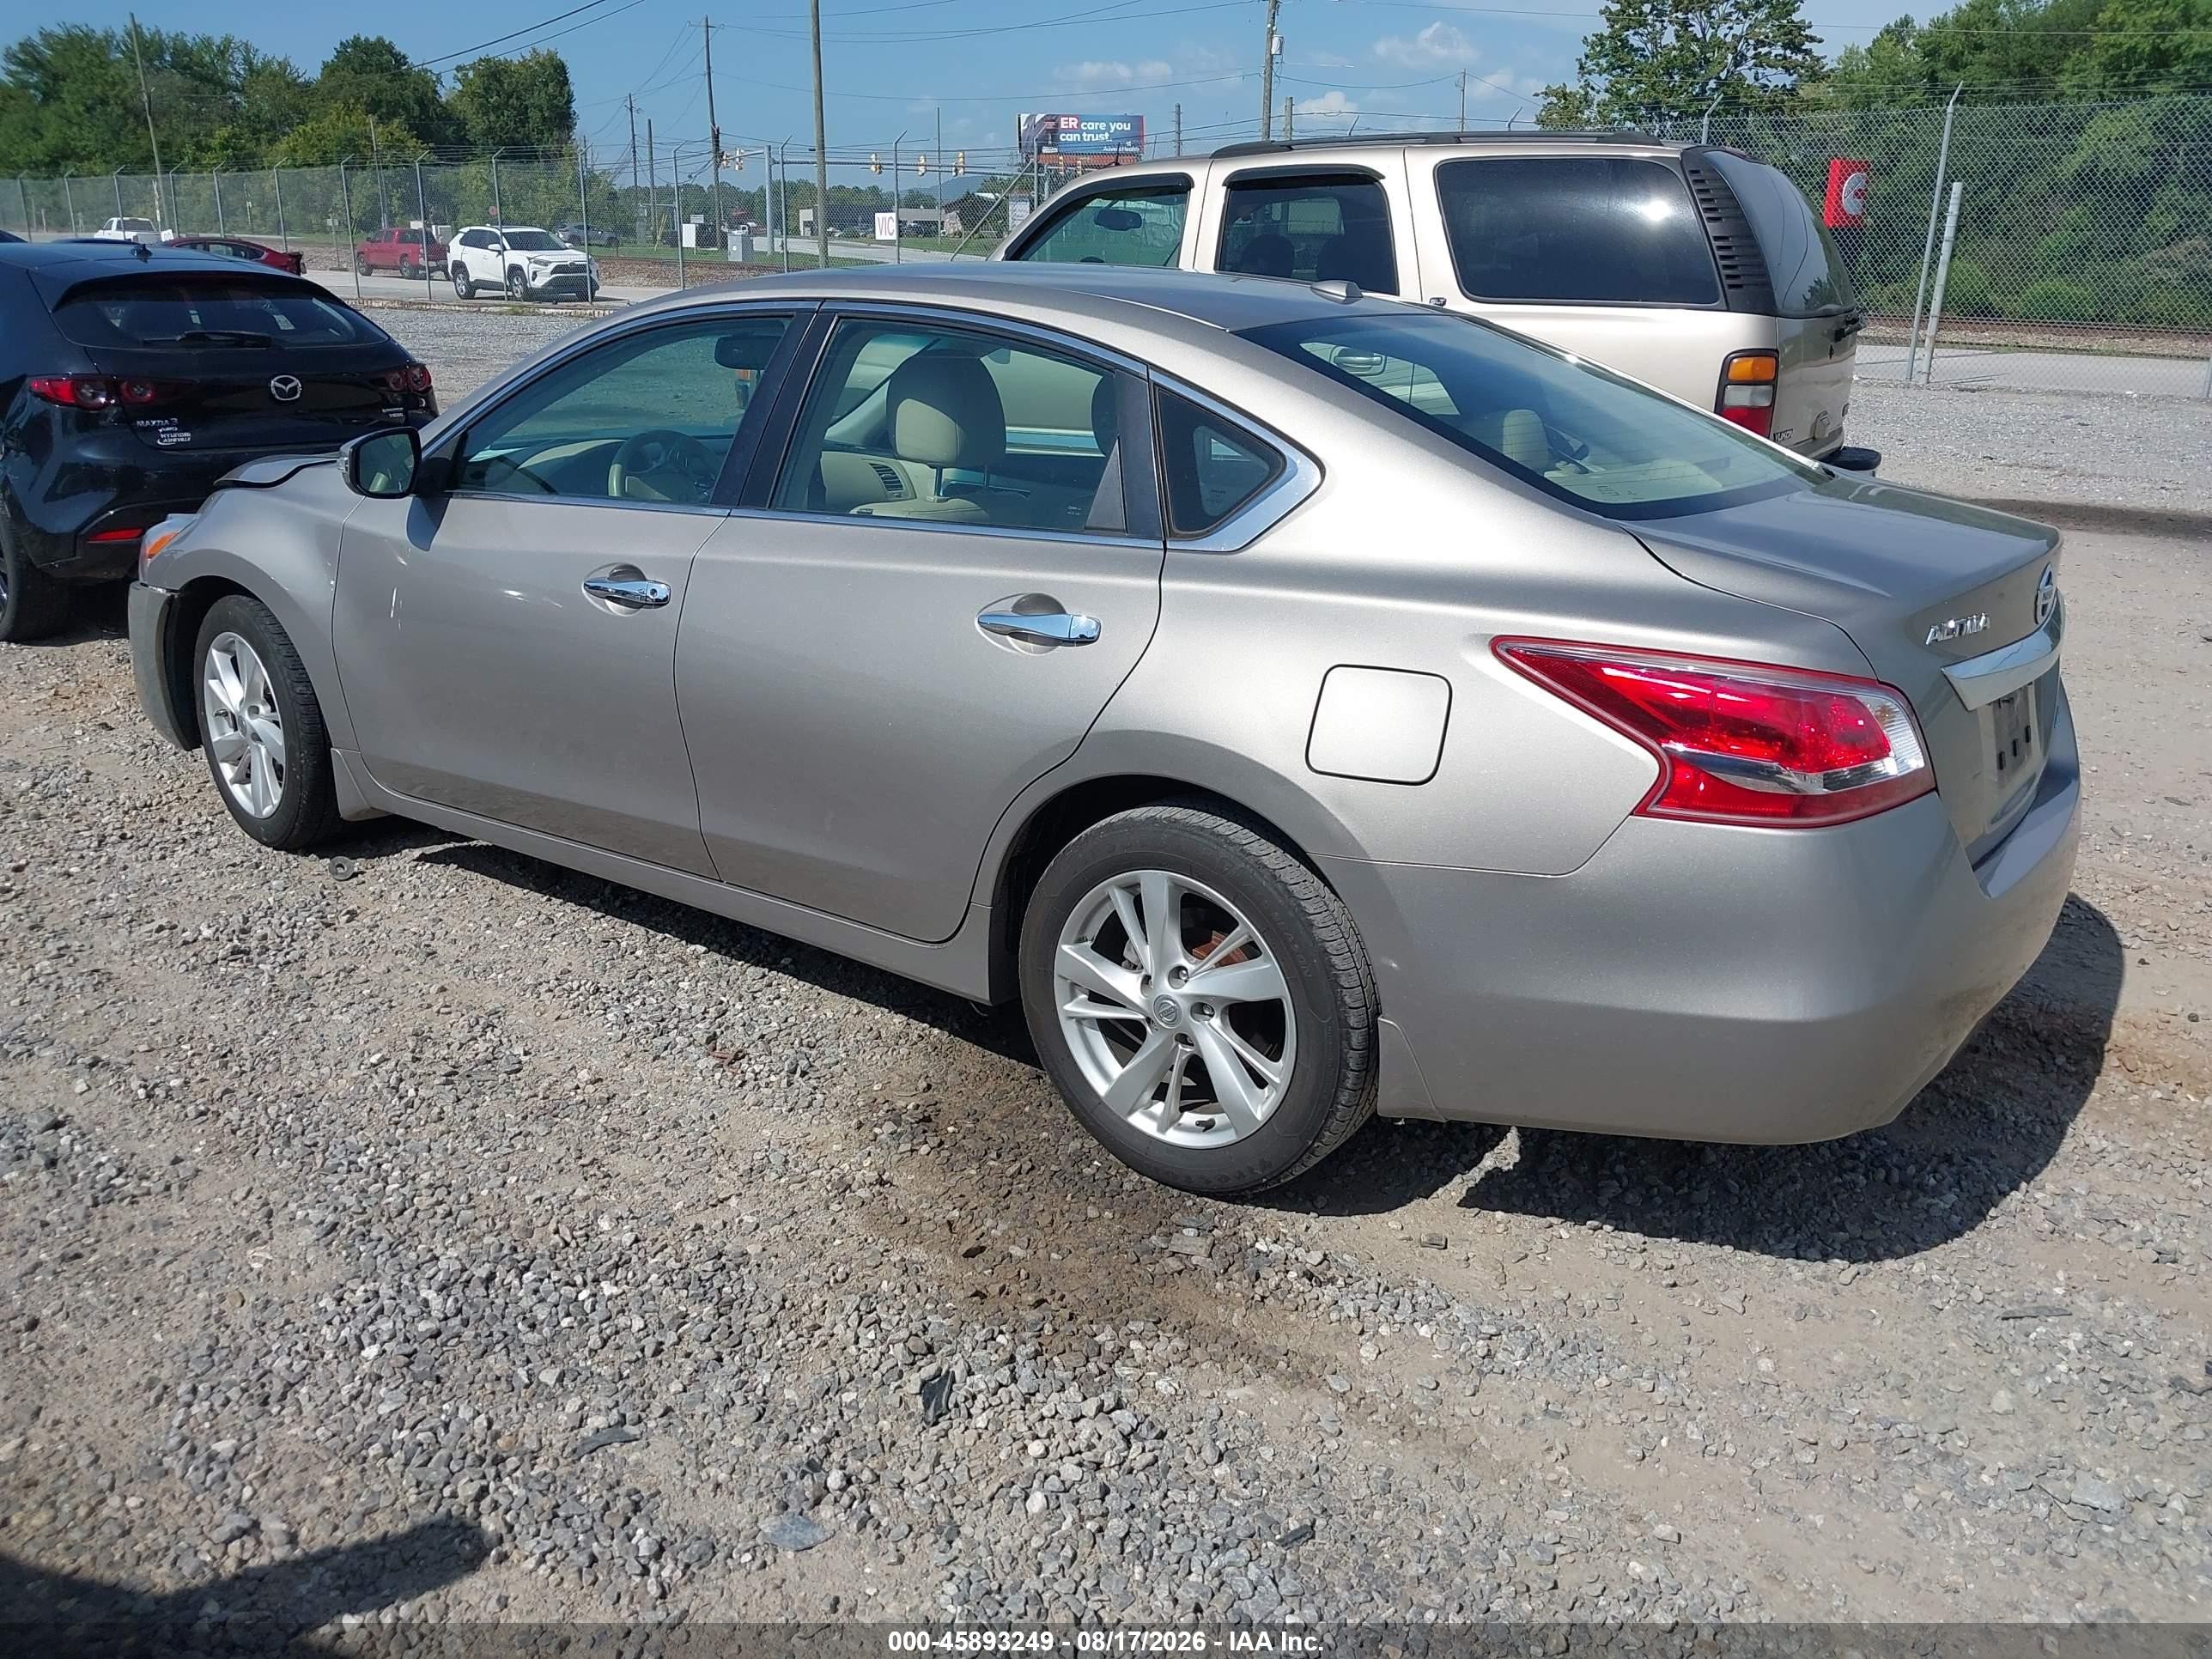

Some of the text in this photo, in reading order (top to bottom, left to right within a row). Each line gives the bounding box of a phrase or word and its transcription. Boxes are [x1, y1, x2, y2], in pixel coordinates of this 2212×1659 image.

[1060, 117, 1079, 129] ER
[1080, 121, 1107, 131] care
[1109, 122, 1131, 133] you
[1059, 132, 1081, 142] can
[877, 216, 895, 236] VIC
[1924, 611, 1991, 646] ALTIMA
